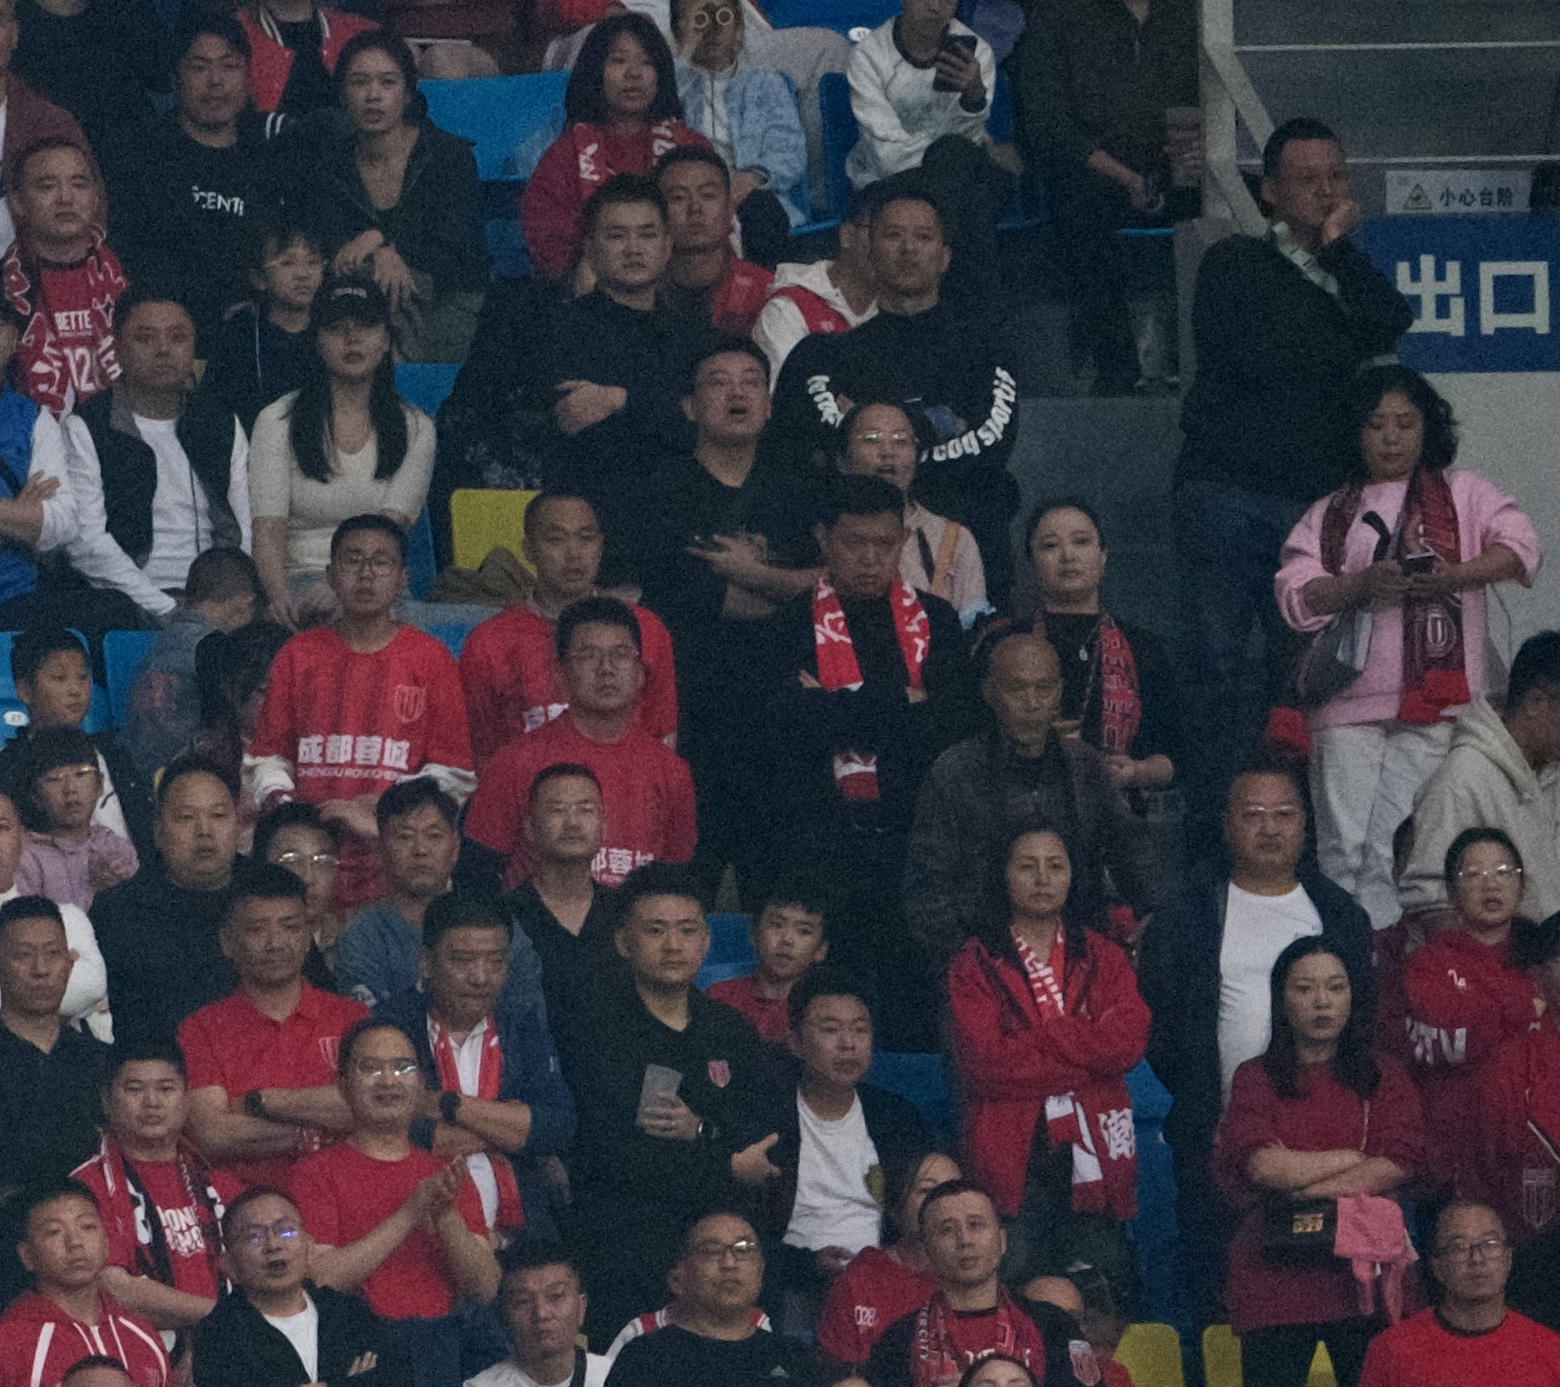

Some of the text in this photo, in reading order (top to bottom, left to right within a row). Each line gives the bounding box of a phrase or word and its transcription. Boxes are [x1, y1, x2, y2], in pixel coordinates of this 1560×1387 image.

[1397, 255, 1550, 336] 出口
[298, 735, 410, 769] 成都蓉城
